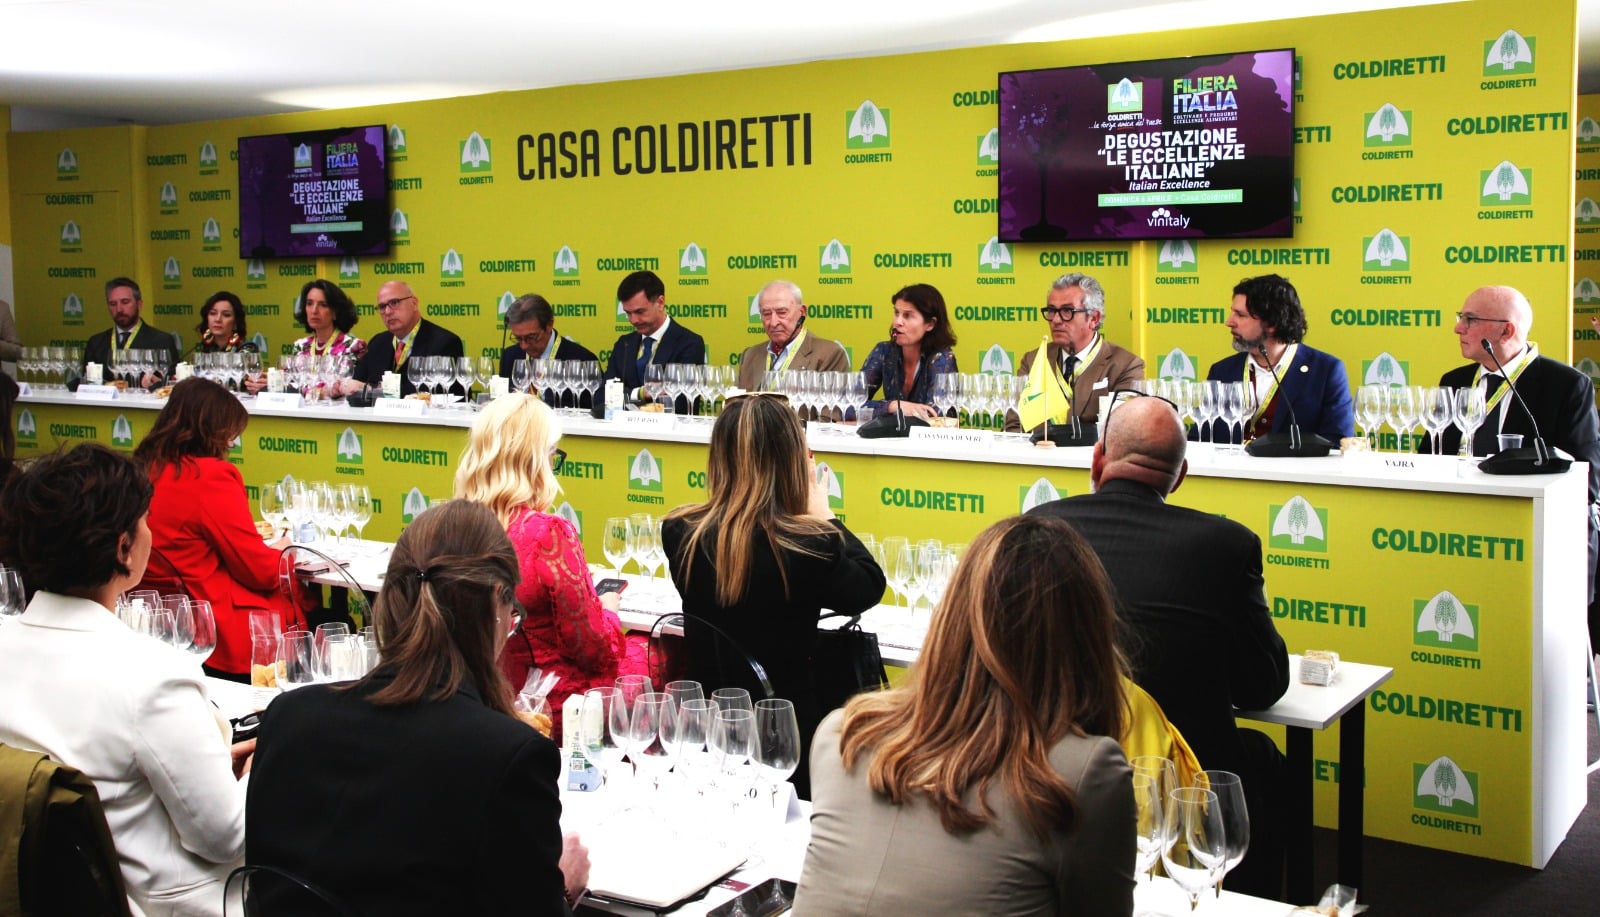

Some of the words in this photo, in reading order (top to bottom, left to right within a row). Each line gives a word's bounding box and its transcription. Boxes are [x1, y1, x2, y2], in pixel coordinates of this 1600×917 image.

[1333, 56, 1445, 80] COLDIRETTI
[1173, 75, 1238, 94] FILIERA
[1480, 78, 1536, 91] COLDIRETTI
[1173, 91, 1238, 113] ITALIA
[1107, 112, 1143, 122] COLDIRETTI
[1447, 112, 1568, 136] COLDIRETTI
[1105, 128, 1238, 150] DEGUSTAZIONE
[326, 142, 359, 154] FILIERA
[517, 129, 600, 181] CASA
[612, 113, 812, 175] COLDIRETTI
[326, 154, 359, 169] ITALIA
[845, 153, 892, 164] COLDIRETTI
[1132, 144, 1245, 165] ECCELLENZE
[1362, 151, 1413, 161] COLDIRETTI
[293, 179, 360, 194] DEGUSTAZIONE
[459, 176, 494, 186] COLDIRETTI
[1129, 181, 1158, 191] Italian
[1160, 180, 1211, 190] Excellence
[307, 190, 363, 204] ECCELLENZE
[1331, 183, 1442, 203] COLDIRETTI
[1147, 215, 1190, 229] vinitaly
[1478, 211, 1533, 220] COLDIRETTI
[315, 240, 337, 249] vinitaly
[874, 254, 952, 268] COLDIRETTI
[1040, 250, 1128, 266] COLDIRETTI
[1228, 248, 1330, 265] COLDIRETTI
[1445, 245, 1565, 263] COLDIRETTI
[373, 262, 424, 275] COLDIRETTI
[480, 260, 535, 273] COLDIRETTI
[597, 258, 658, 271] COLDIRETTI
[728, 255, 797, 269] COLDIRETTI
[192, 265, 234, 278] COLDIRETTI
[279, 264, 316, 276] COLDIRET
[1156, 277, 1199, 285] COLDIRETTI
[1361, 276, 1412, 285] COLDIRETTI
[427, 304, 480, 316] COLDIRETTI
[551, 304, 597, 317] LDIRETTI
[807, 304, 873, 319] OLDIRETTI
[955, 307, 1038, 321] COLDIRETTI
[1331, 309, 1441, 326] COLDIRETTI
[259, 436, 318, 454] COLDIRETTI
[382, 447, 447, 466] COLDIRETTI
[628, 494, 664, 505] COLDIRETTI
[881, 488, 984, 514] COLDIRETTI
[1372, 528, 1523, 562] COLDIRETTI
[1267, 554, 1329, 570] COLDIRETTI
[1269, 597, 1366, 628] DIRETTI
[1411, 651, 1481, 669] COLDIRETTI
[1371, 690, 1523, 732] COLDIRETTI
[1411, 814, 1482, 835] COLDIRETTI
